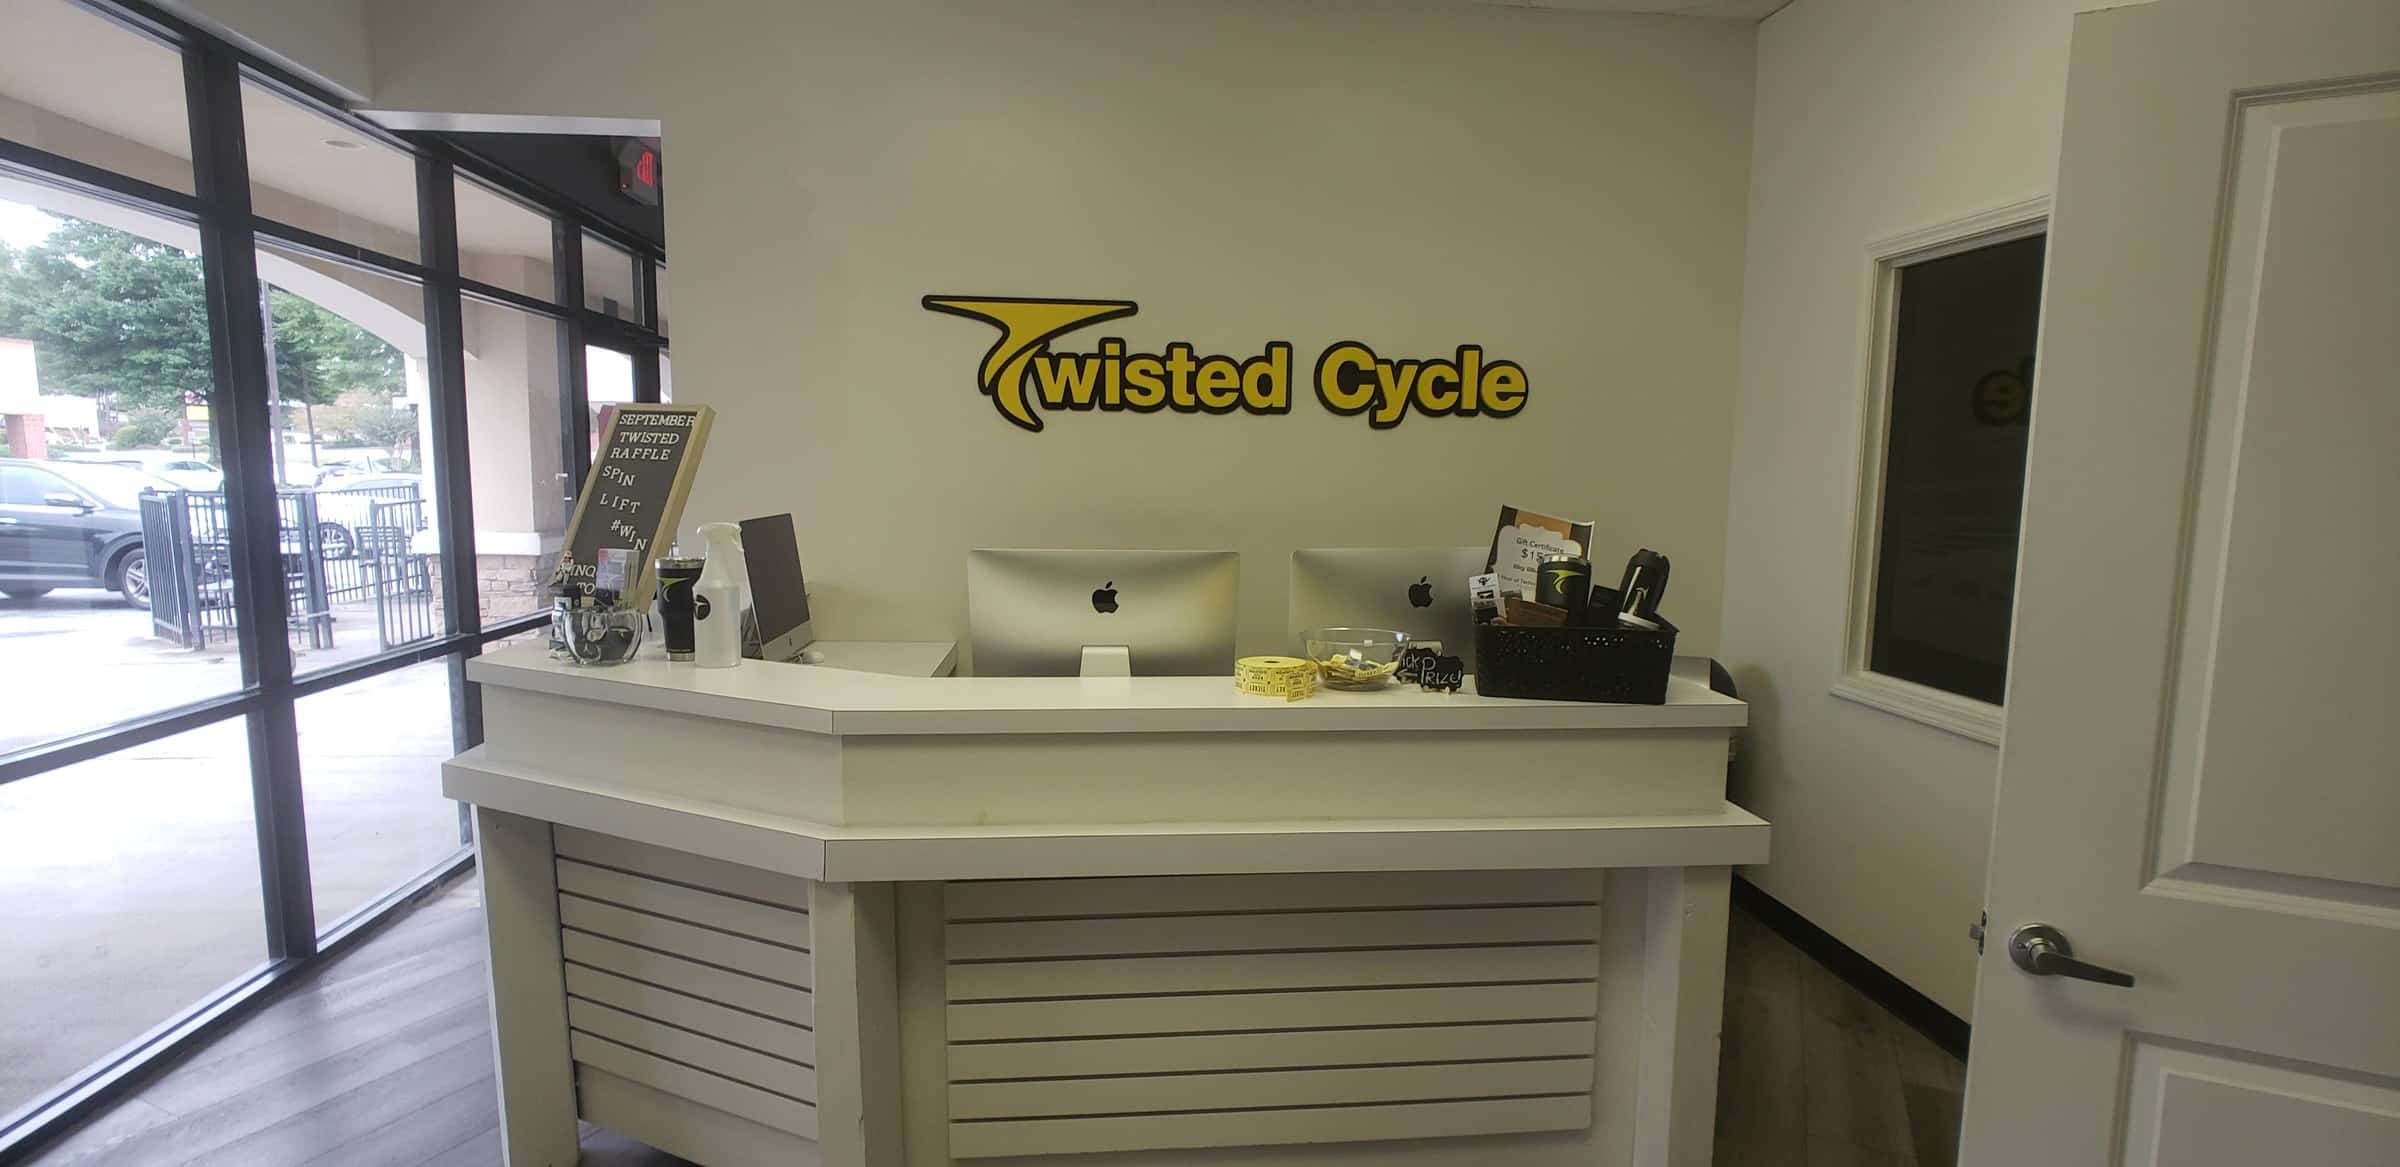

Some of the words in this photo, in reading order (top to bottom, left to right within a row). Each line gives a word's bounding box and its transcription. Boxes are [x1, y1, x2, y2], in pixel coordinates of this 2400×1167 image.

[921, 294, 1292, 432] Twisted
[1314, 340, 1529, 430] Cycle
[618, 413, 696, 428] SEPTEMBER
[619, 431, 680, 445] TWISTED
[610, 447, 672, 461] RAFFLE
[602, 465, 636, 487] SPIN
[599, 492, 641, 514] LIFT
[610, 519, 649, 551] #WIN
